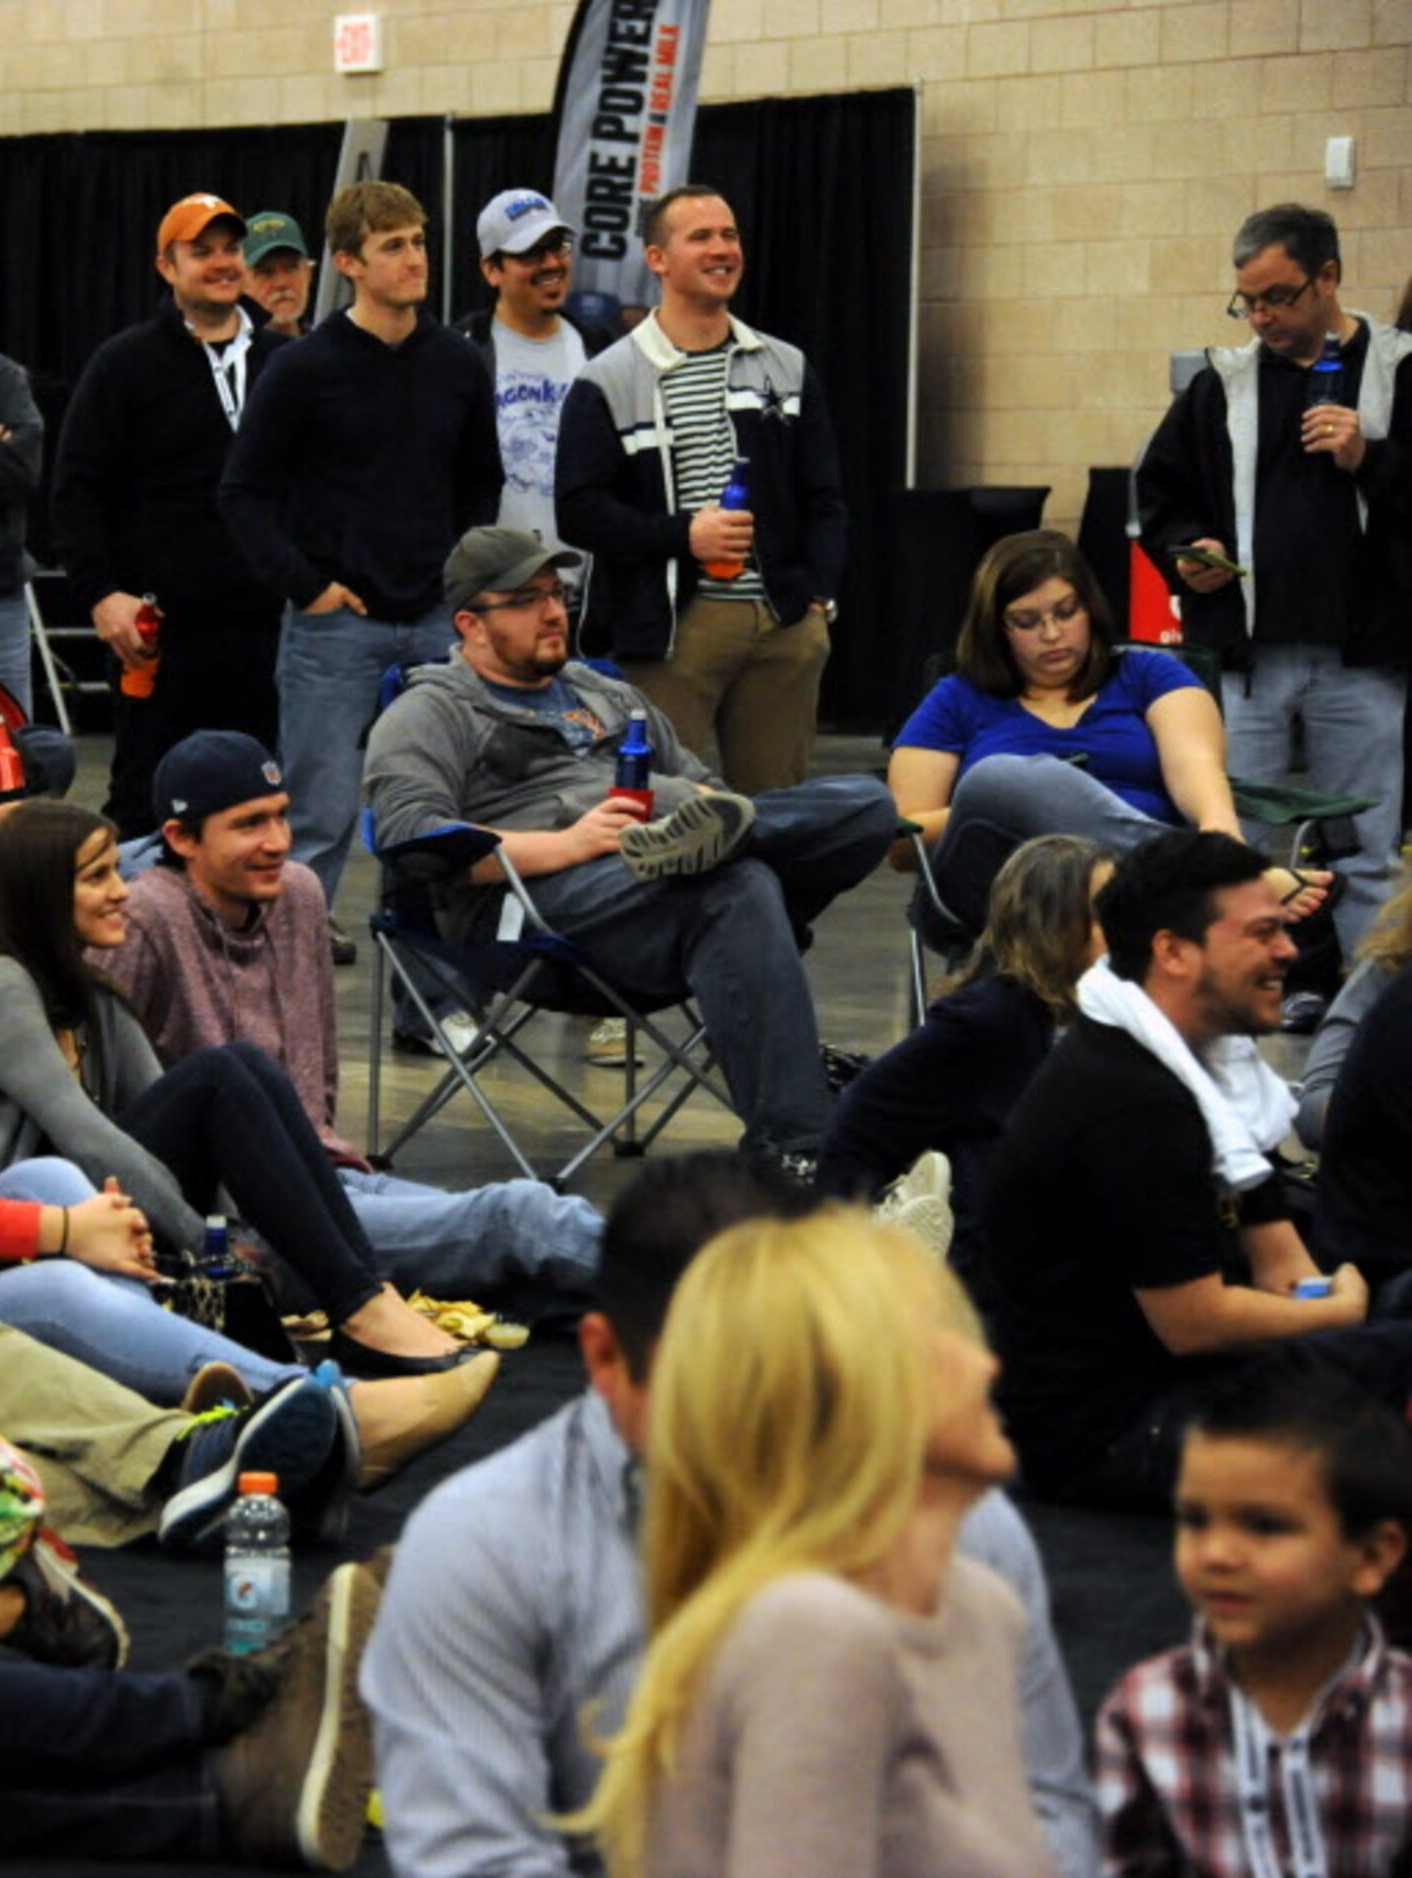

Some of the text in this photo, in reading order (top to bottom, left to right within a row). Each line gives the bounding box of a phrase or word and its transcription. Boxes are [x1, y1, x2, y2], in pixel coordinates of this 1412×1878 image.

[581, 0, 659, 260] CORE POWER
[639, 126, 665, 194] PROTEIN
